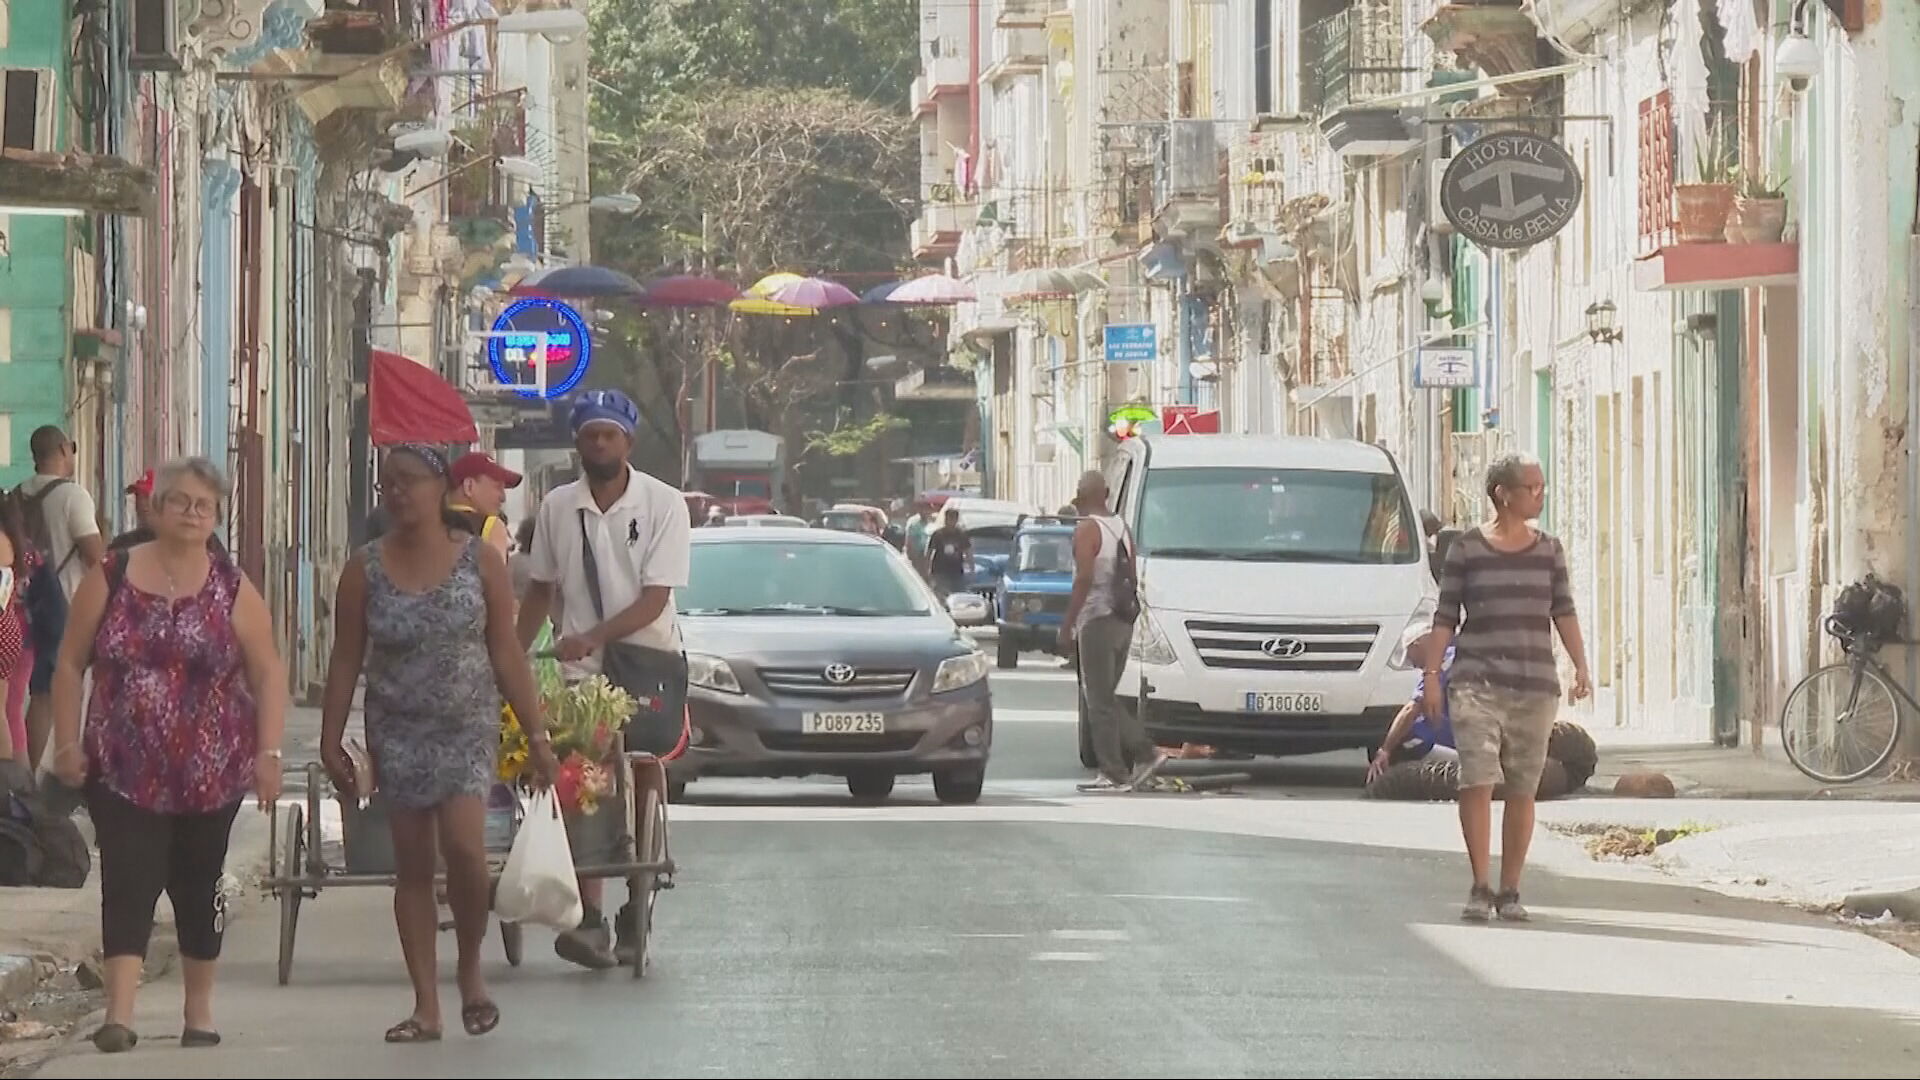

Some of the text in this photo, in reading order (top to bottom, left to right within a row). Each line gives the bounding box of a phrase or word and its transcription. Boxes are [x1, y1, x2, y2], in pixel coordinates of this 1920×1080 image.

[1466, 139, 1544, 170] HOSTAL
[1458, 197, 1571, 240] CASA de BELLA
